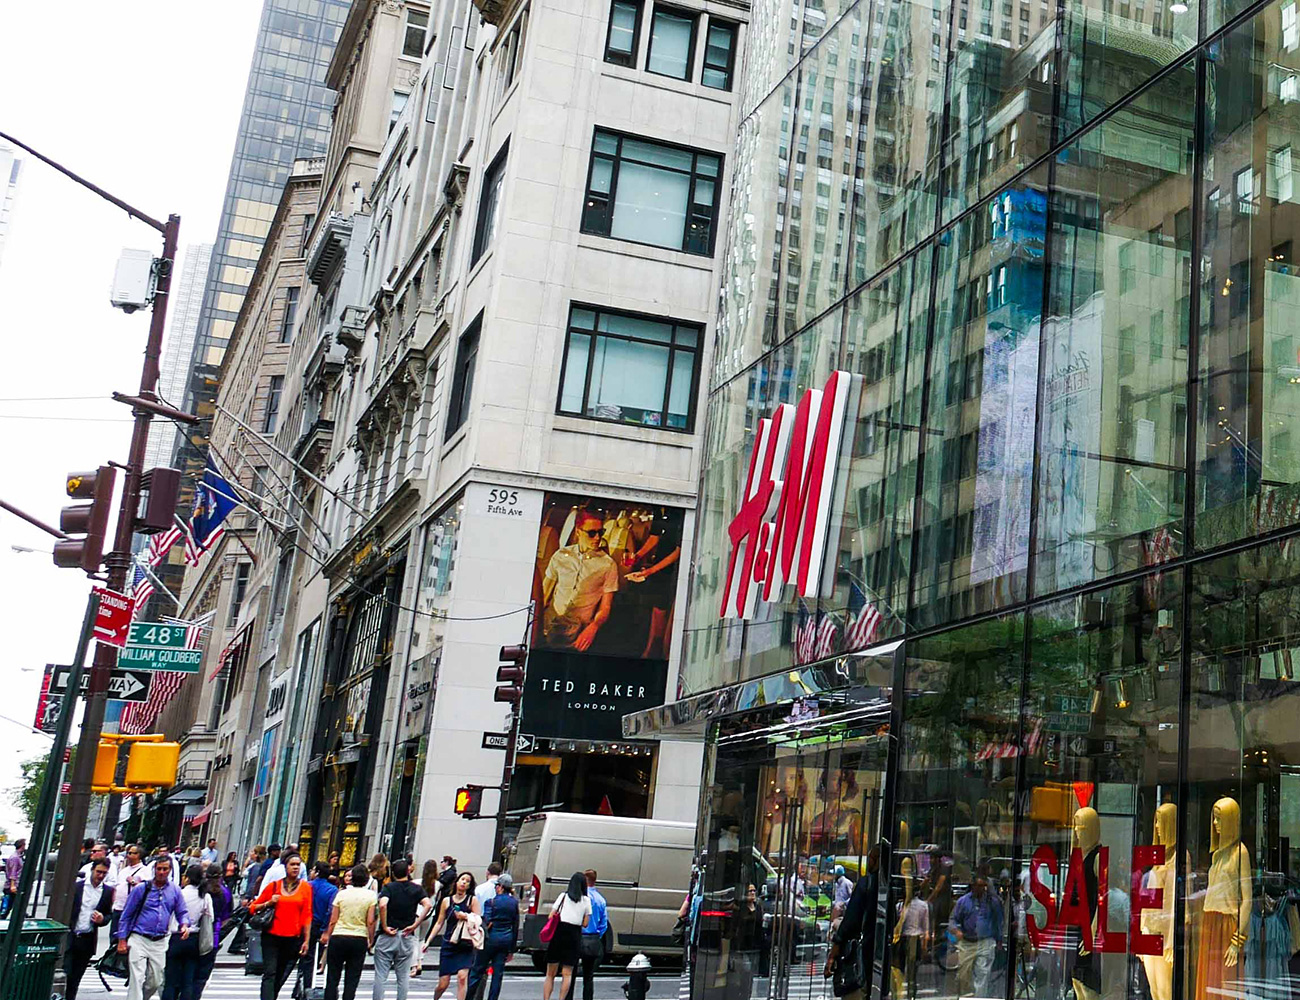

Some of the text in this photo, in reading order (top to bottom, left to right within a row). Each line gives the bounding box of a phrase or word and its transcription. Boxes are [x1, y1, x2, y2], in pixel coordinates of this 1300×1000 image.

[488, 488, 518, 507] 595
[720, 370, 848, 618] H&M
[487, 505, 522, 517] Fifth Ave
[100, 595, 128, 611] STANDING
[98, 606, 112, 618] time
[128, 626, 186, 644] E 48 ST
[121, 648, 201, 664] WILLIAM GOLDBERG
[541, 678, 647, 699] TED BAKER
[567, 702, 617, 712] LONDON
[489, 737, 526, 747] ONE AY
[1026, 843, 1165, 955] SALE
